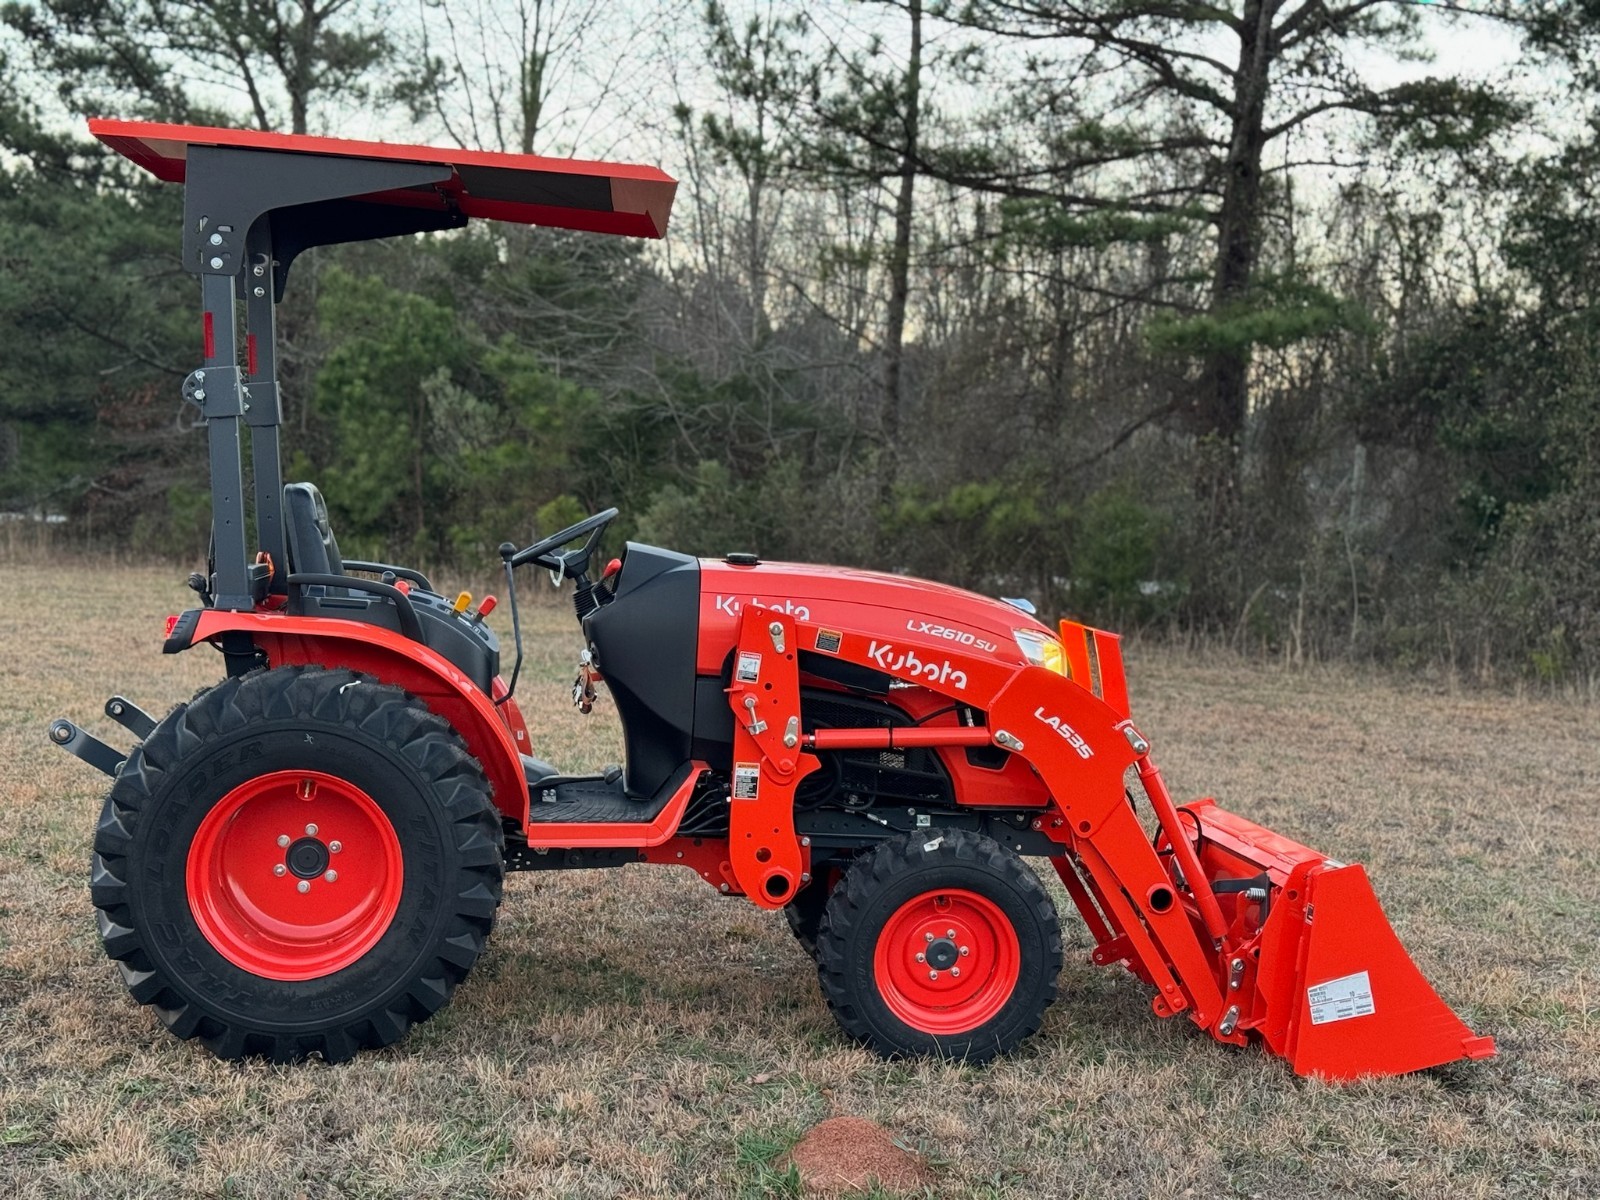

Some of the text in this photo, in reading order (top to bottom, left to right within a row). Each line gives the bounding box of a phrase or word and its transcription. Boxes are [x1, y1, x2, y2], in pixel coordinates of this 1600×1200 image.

[906, 619, 997, 653] LX2610 SU
[868, 640, 967, 690] Kubota
[1034, 706, 1095, 760] LA535
[408, 813, 440, 945] TITAN
